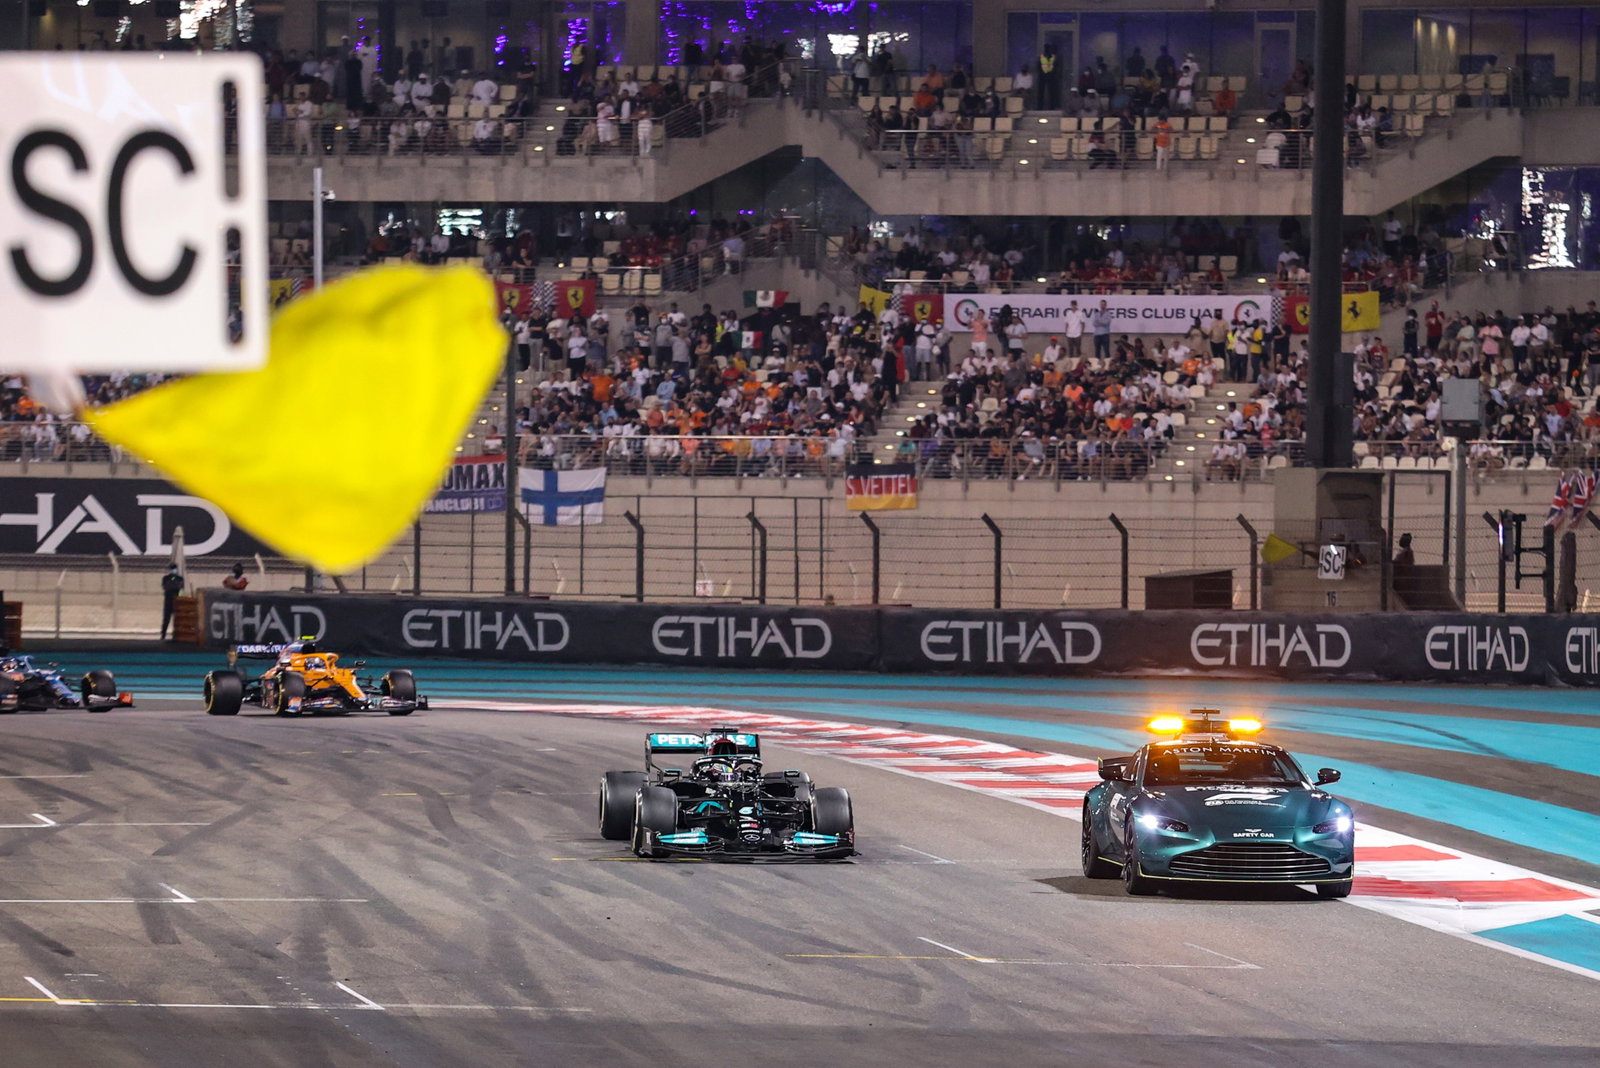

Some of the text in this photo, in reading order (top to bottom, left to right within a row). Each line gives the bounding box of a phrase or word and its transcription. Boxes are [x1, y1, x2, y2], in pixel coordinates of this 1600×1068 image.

[9, 128, 198, 298] SC
[989, 307, 1059, 318] FRRARI
[1142, 308, 1186, 319] CLUB
[860, 474, 914, 498] VETTEL
[1323, 551, 1341, 574] SC
[210, 602, 327, 643] ETIHAD
[402, 609, 570, 652] ETIHAD
[652, 615, 832, 659] ETIHAD
[920, 620, 1102, 664] ETIHAD
[1190, 623, 1352, 668] ETIHAD
[1425, 625, 1530, 672] ETIHAD
[1163, 747, 1276, 756] ASTON MARTIN
